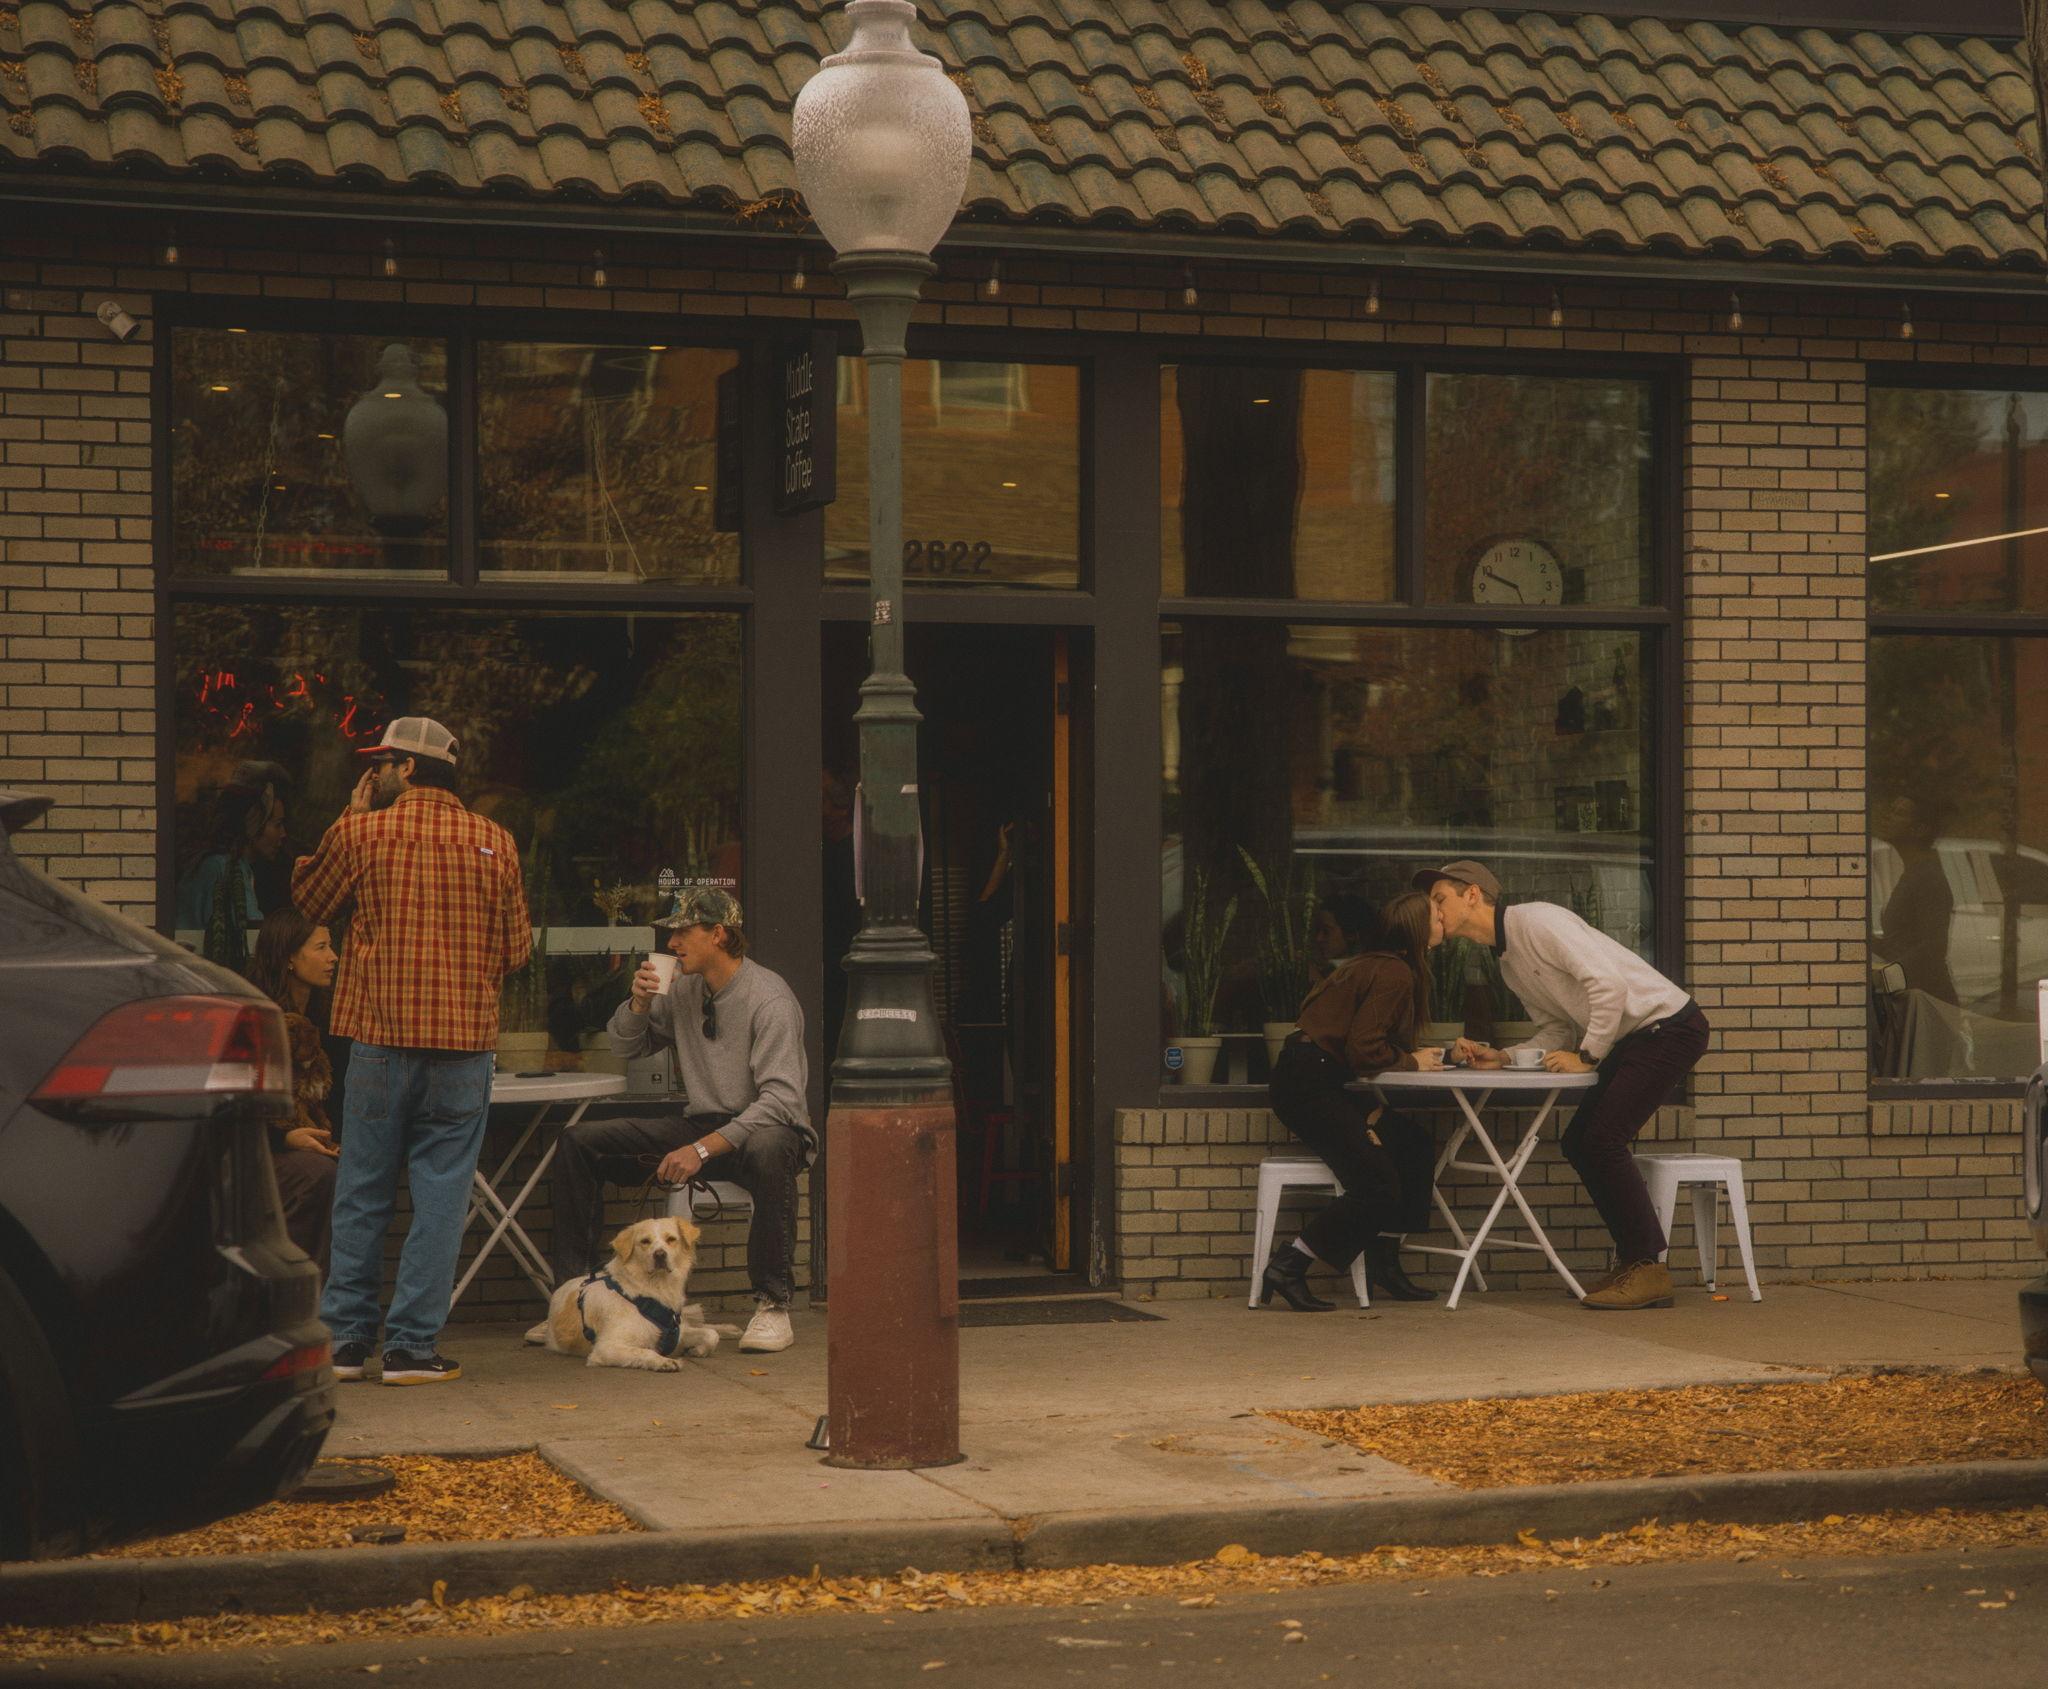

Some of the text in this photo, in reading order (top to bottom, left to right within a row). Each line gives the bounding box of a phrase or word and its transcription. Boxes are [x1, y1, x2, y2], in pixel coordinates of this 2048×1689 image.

[786, 352, 813, 400] Middle
[786, 406, 810, 448] State
[785, 450, 812, 494] Coffee
[903, 540, 992, 575] 2622
[1495, 552, 1502, 562] 11
[1510, 547, 1520, 557] 12
[1482, 565, 1492, 576] 10
[1540, 563, 1546, 574] 2
[1479, 583, 1486, 592] 9
[1546, 581, 1552, 591] 3
[658, 878, 736, 886] HOURS OF OPERATION
